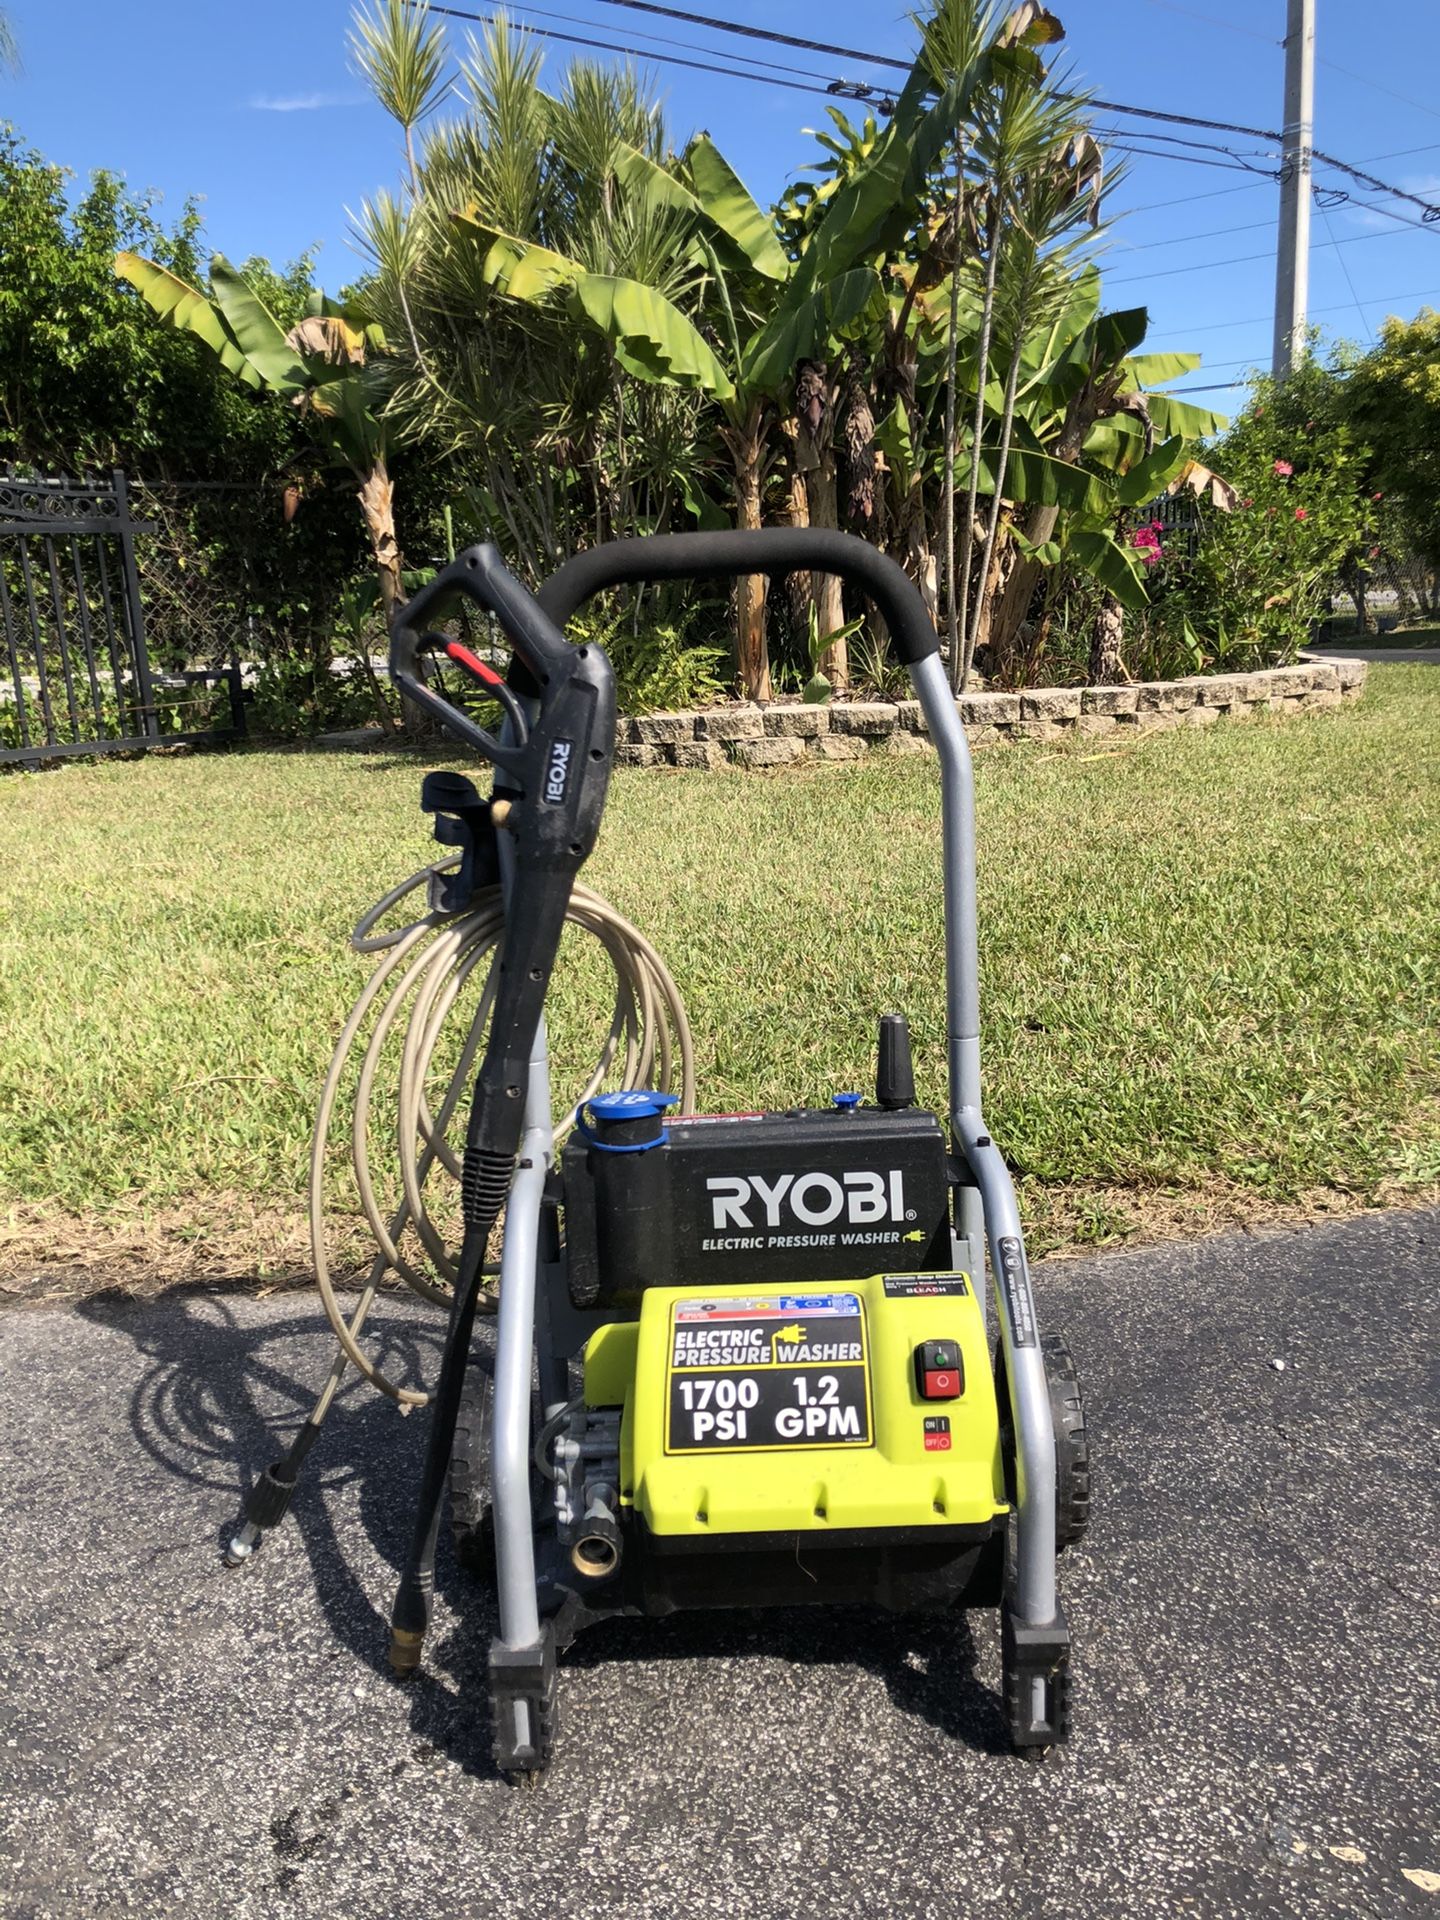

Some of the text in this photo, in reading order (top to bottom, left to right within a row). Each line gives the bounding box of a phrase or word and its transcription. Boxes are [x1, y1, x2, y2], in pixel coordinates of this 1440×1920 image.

[546, 743, 571, 800] RYOBI
[706, 1170, 904, 1229] RYOBI
[702, 1232, 900, 1250] ELECTRIC PRESSURE WASHER
[675, 1329, 763, 1348] ELECTRIC
[673, 1343, 861, 1366] PRESSURE WASHER
[679, 1375, 839, 1410] 1700 1.2
[693, 1406, 860, 1441] PSI GPM
[925, 1421, 936, 1429] ON
